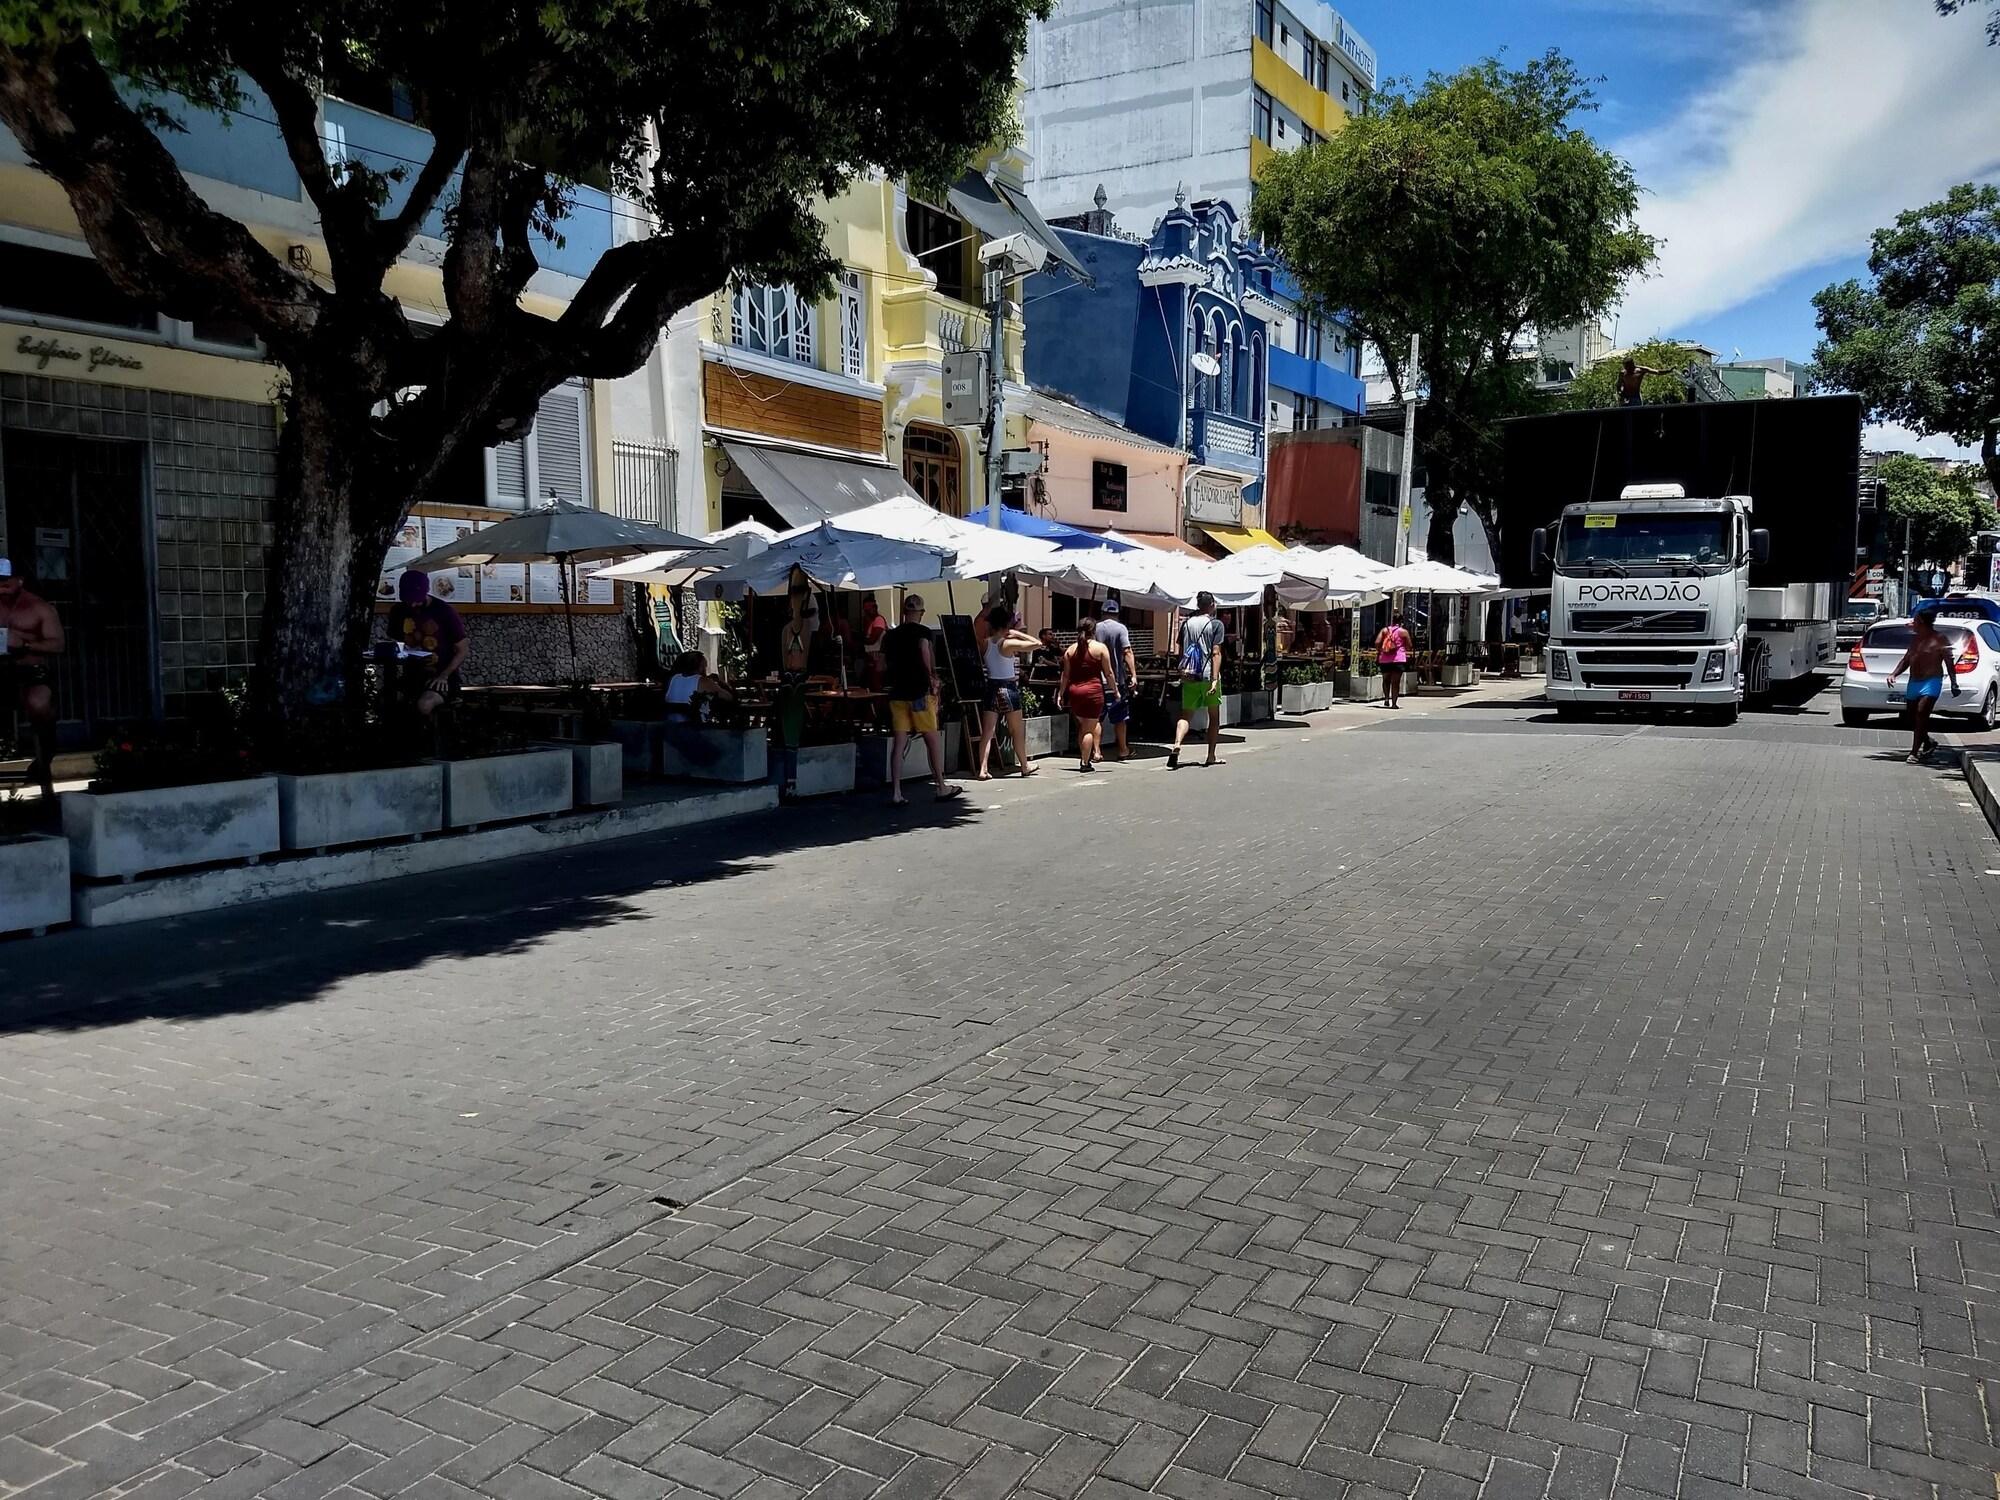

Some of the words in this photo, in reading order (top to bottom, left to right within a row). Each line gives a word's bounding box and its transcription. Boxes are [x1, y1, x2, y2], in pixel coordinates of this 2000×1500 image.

[1344, 33, 1356, 57] HIT
[1355, 44, 1375, 78] HOTEL
[952, 383, 967, 392] 008
[1579, 581, 1700, 601] PORRADÃO
